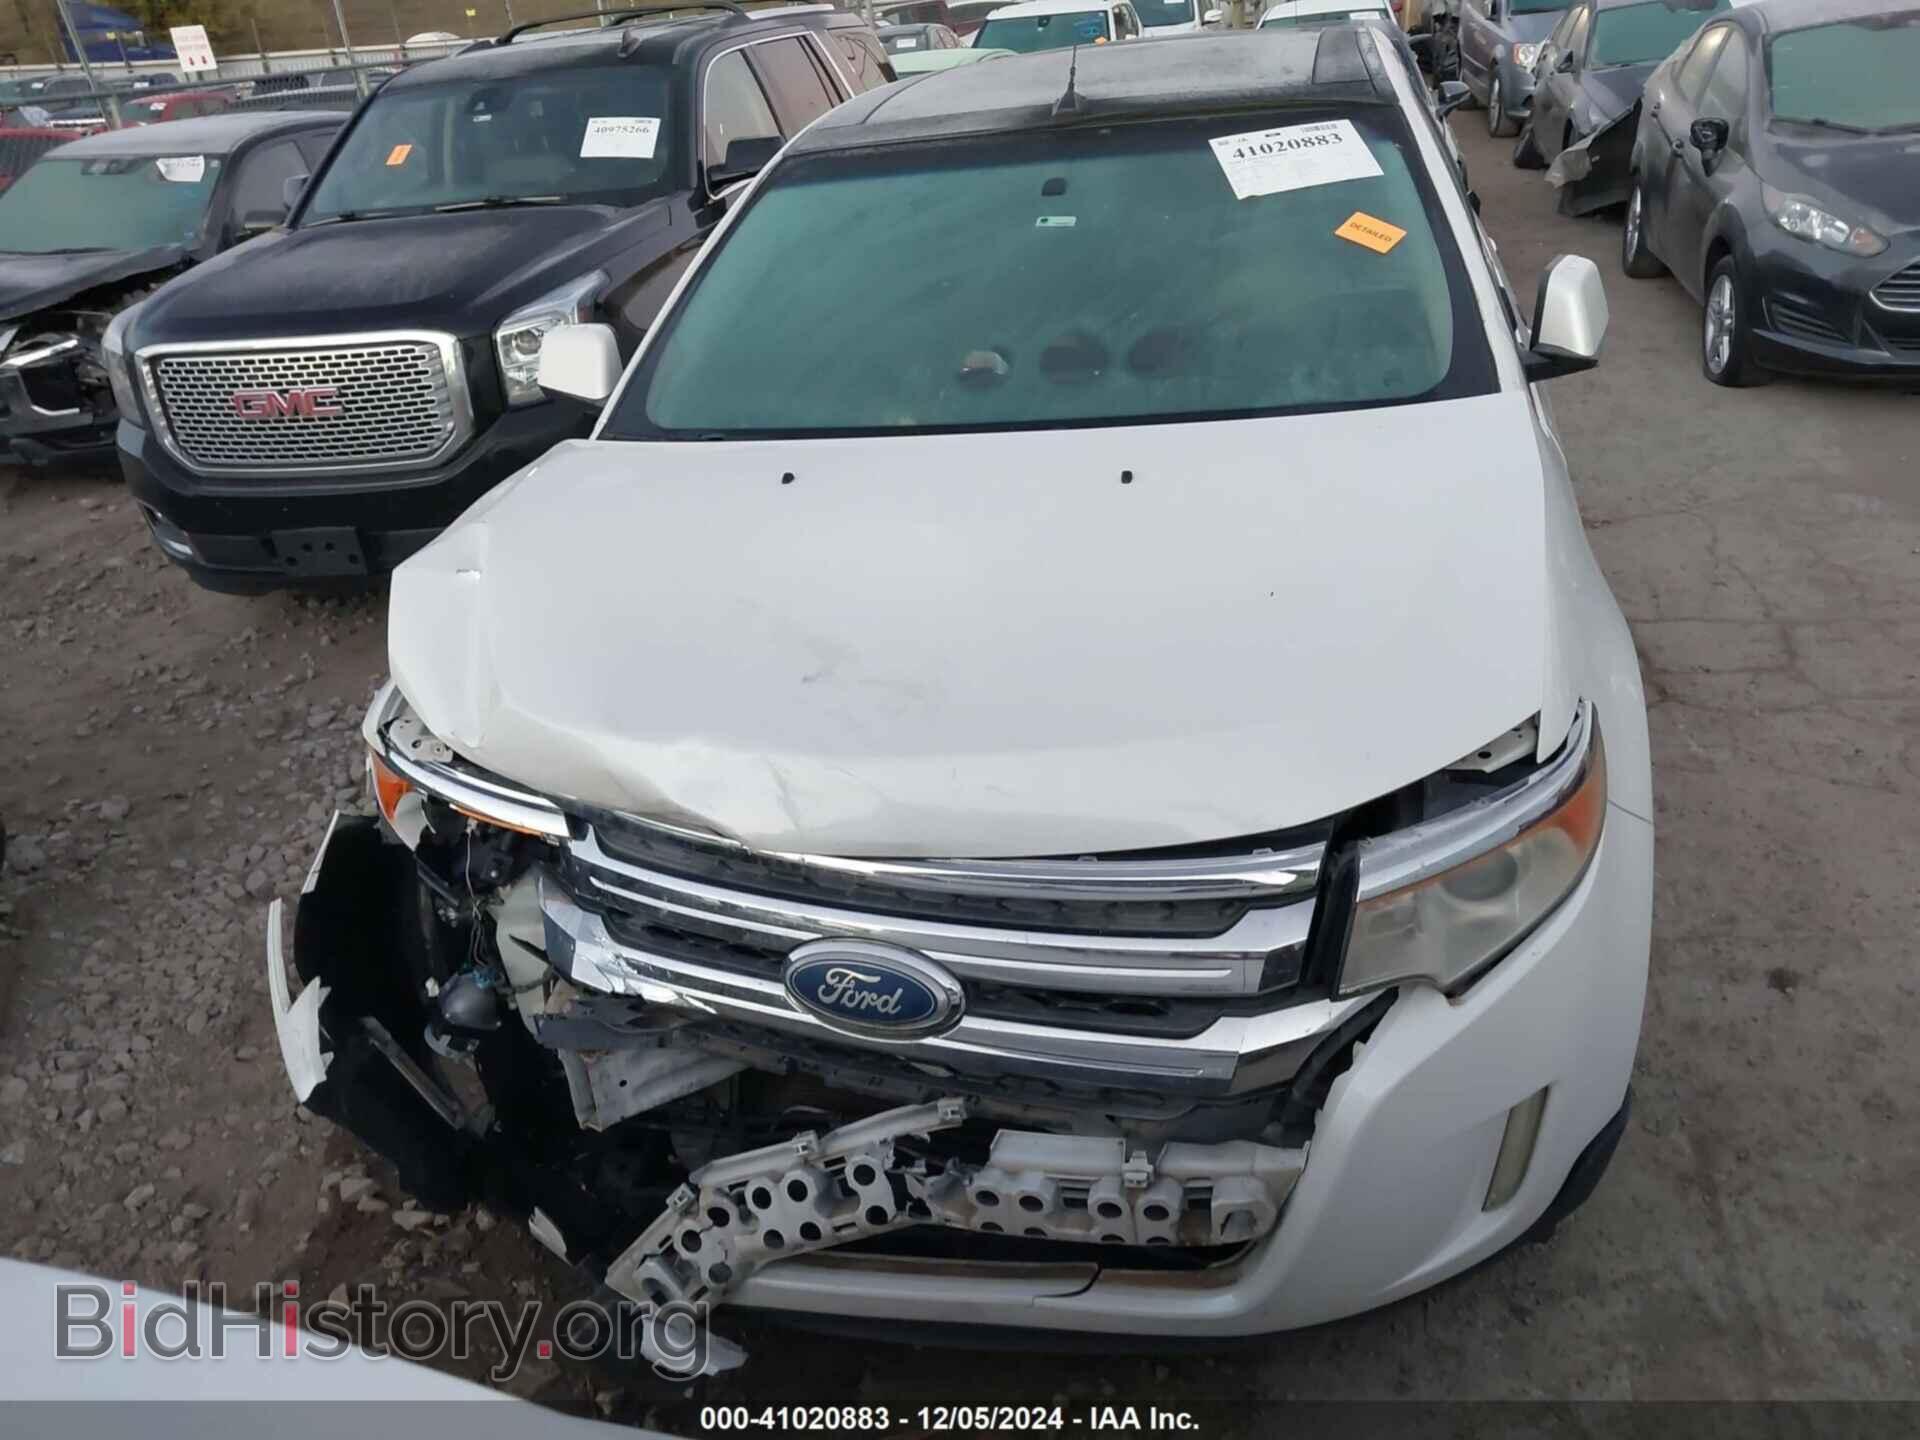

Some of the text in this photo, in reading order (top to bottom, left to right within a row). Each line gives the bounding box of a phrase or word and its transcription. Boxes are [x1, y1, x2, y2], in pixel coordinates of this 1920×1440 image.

[1232, 132, 1344, 160] 41020883
[1349, 221, 1393, 242] DETAILED
[232, 387, 344, 418] GMC
[817, 967, 904, 1015] Ford
